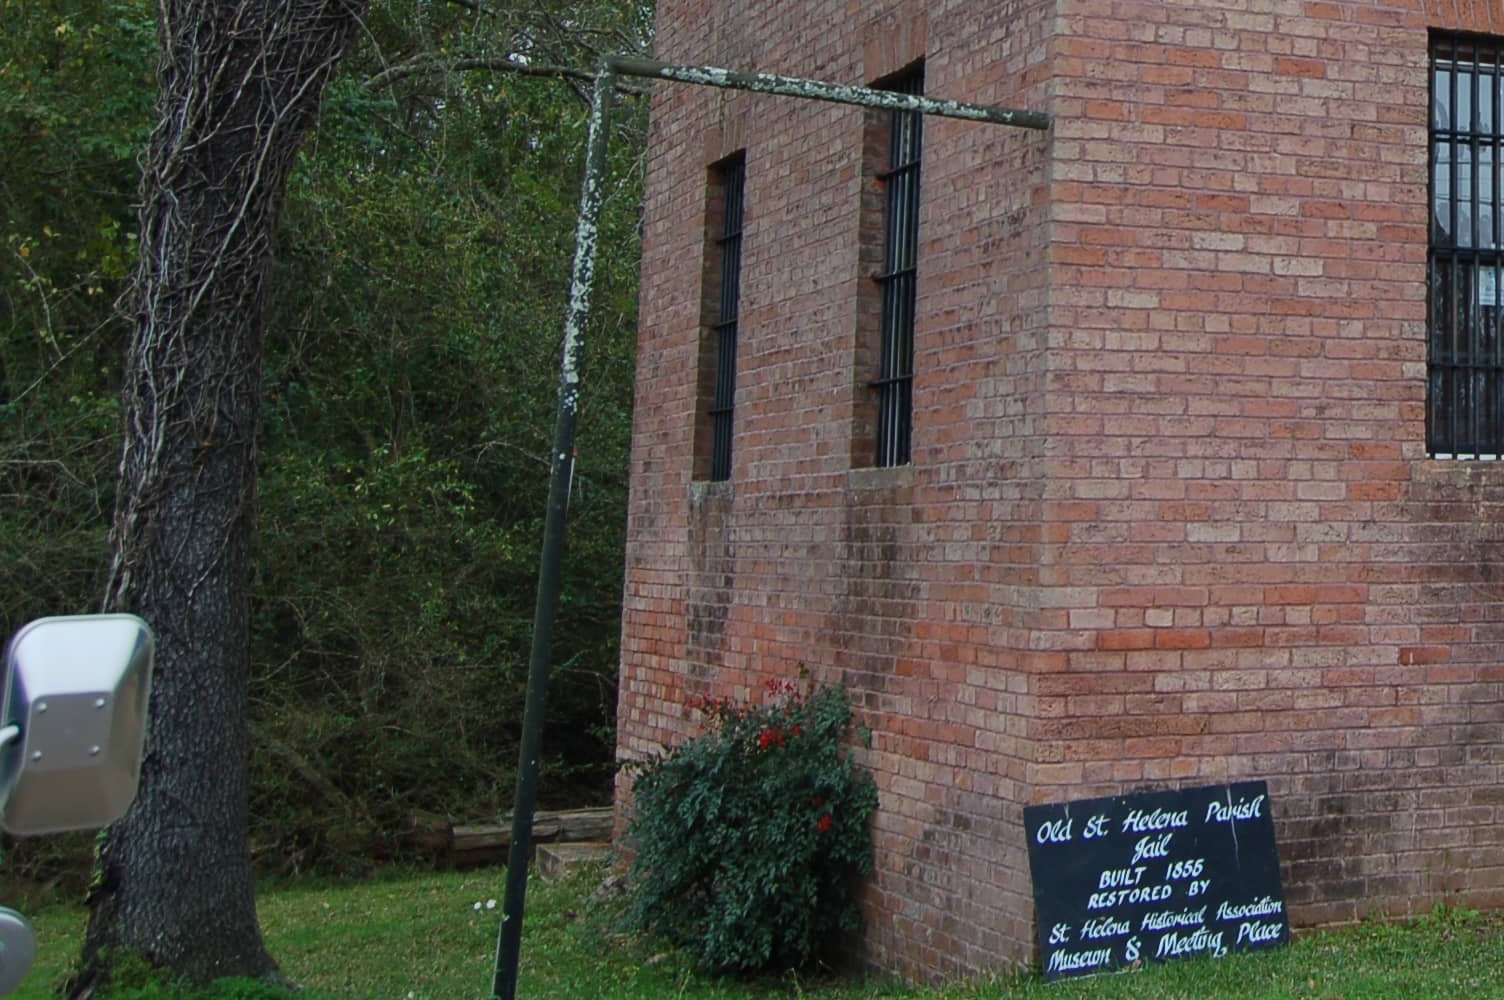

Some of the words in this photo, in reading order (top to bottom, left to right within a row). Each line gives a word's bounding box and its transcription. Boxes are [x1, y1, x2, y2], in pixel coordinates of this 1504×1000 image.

[1037, 820, 1071, 843] Old
[1084, 815, 1109, 837] St.
[1123, 808, 1187, 833] Helena
[1206, 796, 1263, 822] Parish
[1132, 834, 1173, 864] Jail
[1088, 885, 1171, 909] RESTORED
[1190, 880, 1210, 896] BY
[1100, 867, 1146, 889] BUILT
[1050, 924, 1070, 944] St.
[1081, 917, 1129, 940] Helena
[1142, 906, 1205, 930] Historical
[1217, 897, 1281, 920] Association
[1048, 948, 1110, 972] Museum
[1127, 936, 1141, 961] &
[1156, 927, 1227, 956] Meeting
[1237, 923, 1282, 943] Place
